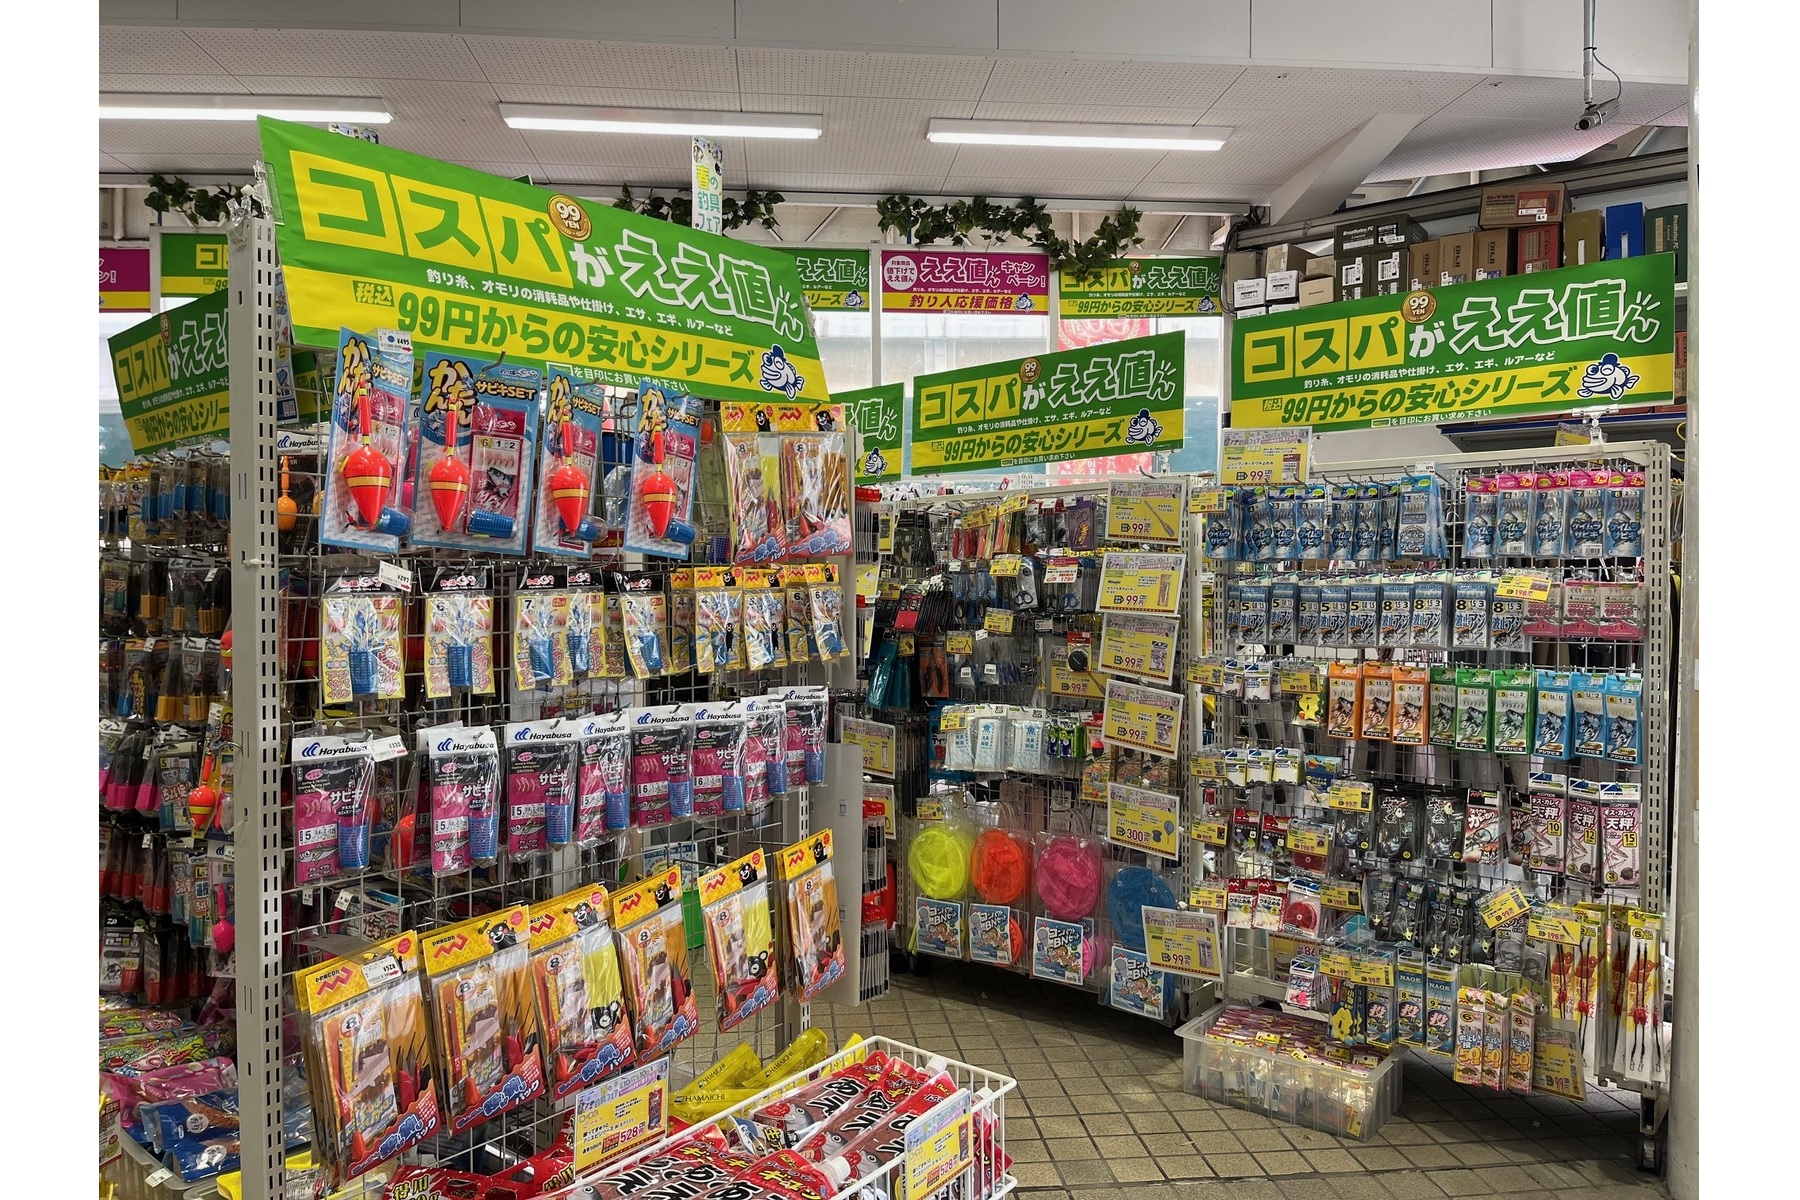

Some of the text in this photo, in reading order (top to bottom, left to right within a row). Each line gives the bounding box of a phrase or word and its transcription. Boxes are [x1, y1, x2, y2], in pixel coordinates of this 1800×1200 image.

[556, 202, 581, 220] 99
[562, 219, 580, 230] YEN
[920, 256, 1001, 288] ええ値ん
[356, 283, 391, 306] 税込
[909, 294, 1013, 310] 釣り人応援価格
[1077, 299, 1196, 313] 99円からの安心シリーズ
[1409, 296, 1429, 310] 99
[1411, 308, 1426, 316] YEN
[398, 292, 755, 384] 99円からの安心シリーズ
[1024, 361, 1037, 372] 99
[476, 381, 536, 400] サビキSET
[1281, 364, 1578, 424] 99円からの安心シリーズ
[1391, 408, 1492, 425] を目印にお買い求め下さい
[943, 418, 1125, 461] 99円からの安心シリーズ
[1250, 470, 1263, 481] 99
[1132, 523, 1143, 534] 99
[1500, 522, 1527, 531] ケイムラ
[1537, 523, 1562, 532] ケイムラ
[1571, 522, 1601, 531] ケイムラ
[1608, 522, 1640, 531] ケイムラ
[1515, 589, 1527, 597] 198
[1126, 595, 1138, 606] 99
[1242, 602, 1250, 611] 5
[1350, 602, 1359, 611] 5
[1383, 601, 1392, 610] 8
[1415, 599, 1424, 609] 8
[1457, 600, 1466, 610] 8
[1322, 602, 1330, 612] 5
[1493, 602, 1503, 613] 8
[1382, 613, 1410, 630] 波止アジ
[1413, 612, 1442, 628] 波止アジ
[1455, 612, 1487, 630] 波止アジ
[1492, 616, 1524, 633] 波止アジ
[1124, 656, 1136, 667] 99
[650, 716, 690, 724] Hayabusa
[594, 725, 625, 734] Hayabusa
[1129, 729, 1140, 740] 99
[529, 732, 572, 740] Hayabusa
[661, 753, 688, 765] サビキ
[539, 772, 568, 785] サビキ
[463, 785, 492, 798] サビキ
[1532, 806, 1559, 820] 天秤
[1572, 812, 1594, 827] 天秤
[1606, 818, 1635, 831] 天秤
[1549, 823, 1559, 832] 10
[1126, 828, 1144, 842] 300
[1586, 830, 1595, 840] 12
[1624, 833, 1635, 843] 15
[1501, 909, 1510, 919] 99
[1547, 931, 1560, 940] 198
[1172, 953, 1184, 965] 99
[760, 989, 776, 1009] パック
[680, 1020, 697, 1039] パック
[610, 1046, 631, 1071] パック
[770, 1051, 793, 1075] HAMAICHI
[704, 1063, 727, 1084] HAMAICHI
[1555, 1076, 1564, 1089] 99
[516, 1080, 540, 1107] パック
[685, 1094, 725, 1102] HAMAICHI
[411, 1116, 437, 1147] パック
[620, 1126, 638, 1143] 528
